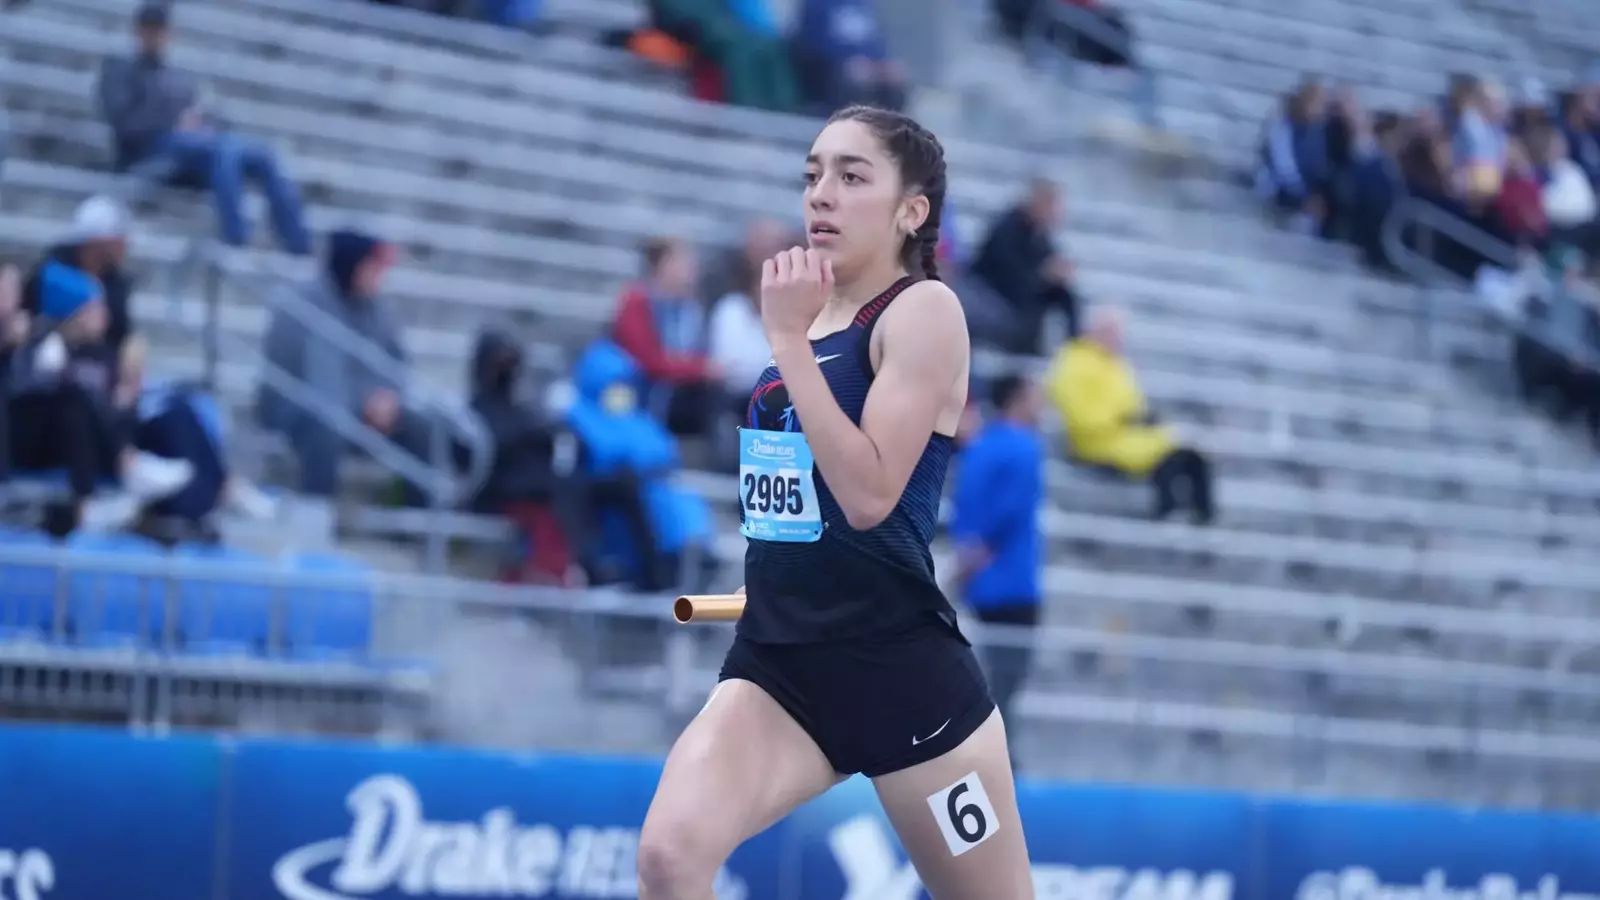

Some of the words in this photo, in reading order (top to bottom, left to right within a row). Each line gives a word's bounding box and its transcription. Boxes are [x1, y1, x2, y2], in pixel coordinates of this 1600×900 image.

[744, 473, 804, 516] 2995
[330, 773, 562, 897] Drake
[946, 782, 988, 844] 6
